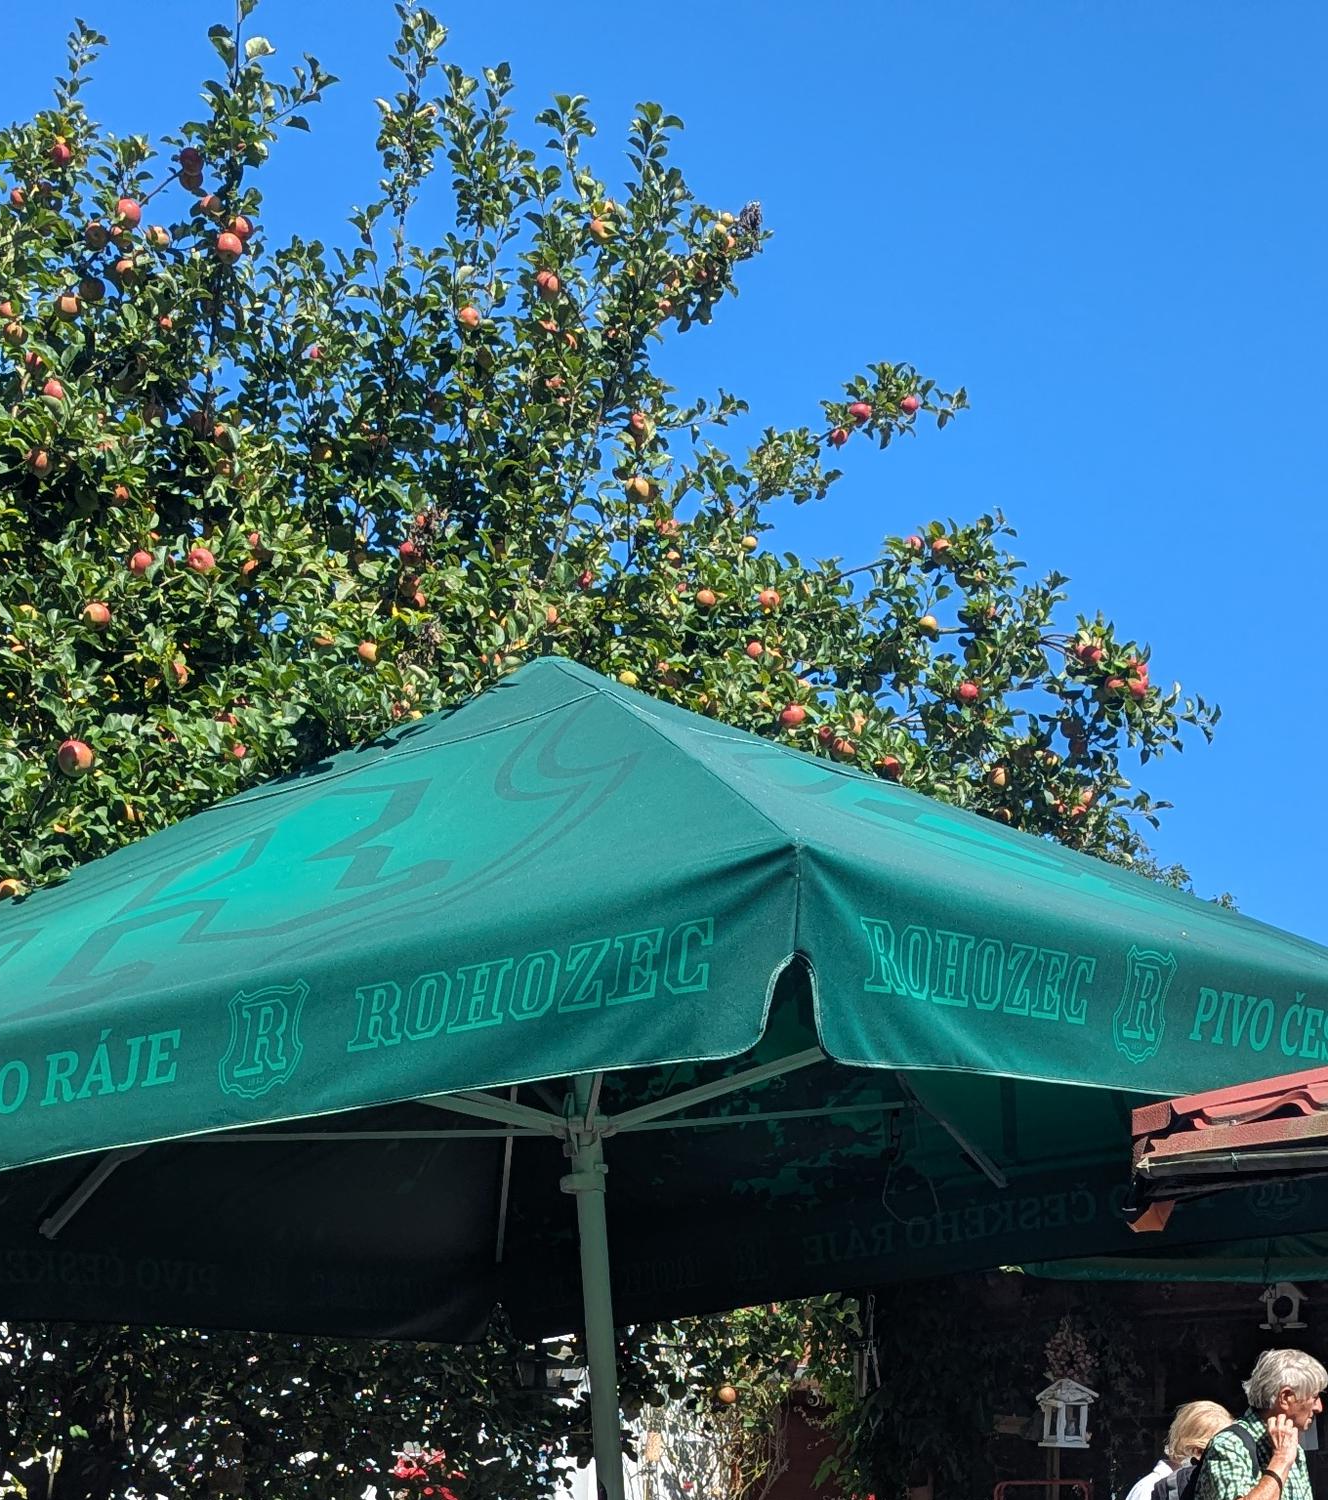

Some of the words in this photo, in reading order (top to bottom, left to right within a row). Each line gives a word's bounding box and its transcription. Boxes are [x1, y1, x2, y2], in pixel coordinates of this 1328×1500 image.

[40, 1029, 181, 1106] RÁJE
[348, 917, 714, 1052] ROHOZEC
[860, 916, 1096, 1025] ROHOZEC
[1189, 987, 1275, 1051] PIVO
